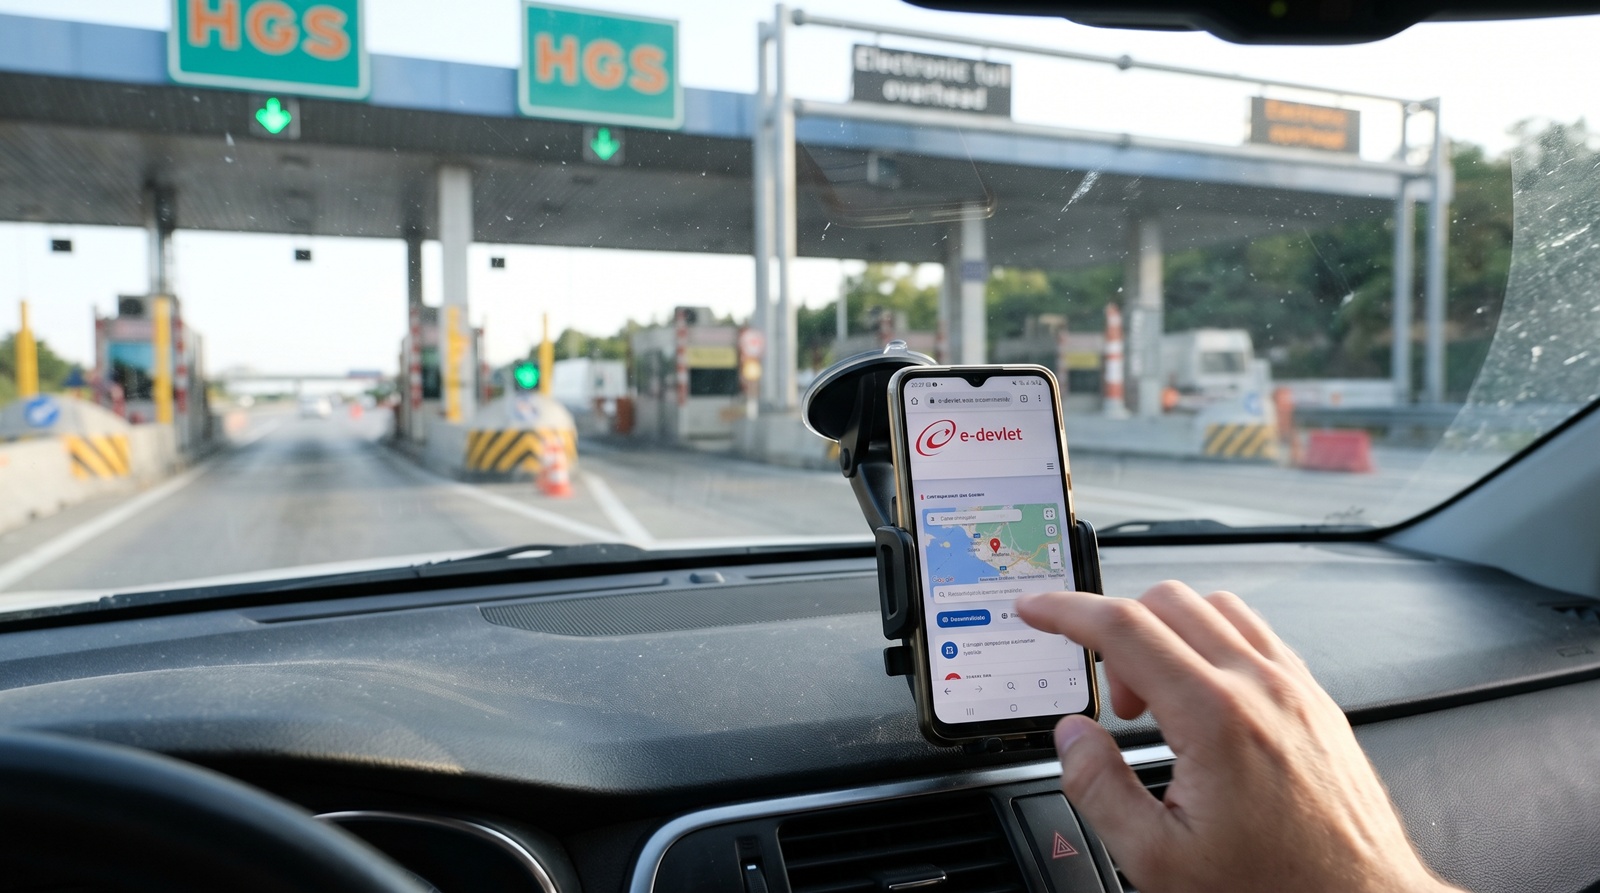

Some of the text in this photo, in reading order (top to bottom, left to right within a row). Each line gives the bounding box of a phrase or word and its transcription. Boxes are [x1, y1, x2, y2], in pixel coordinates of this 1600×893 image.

[187, 0, 351, 61] HGS
[535, 32, 669, 95] HGS
[960, 427, 1023, 442] e-devlet
